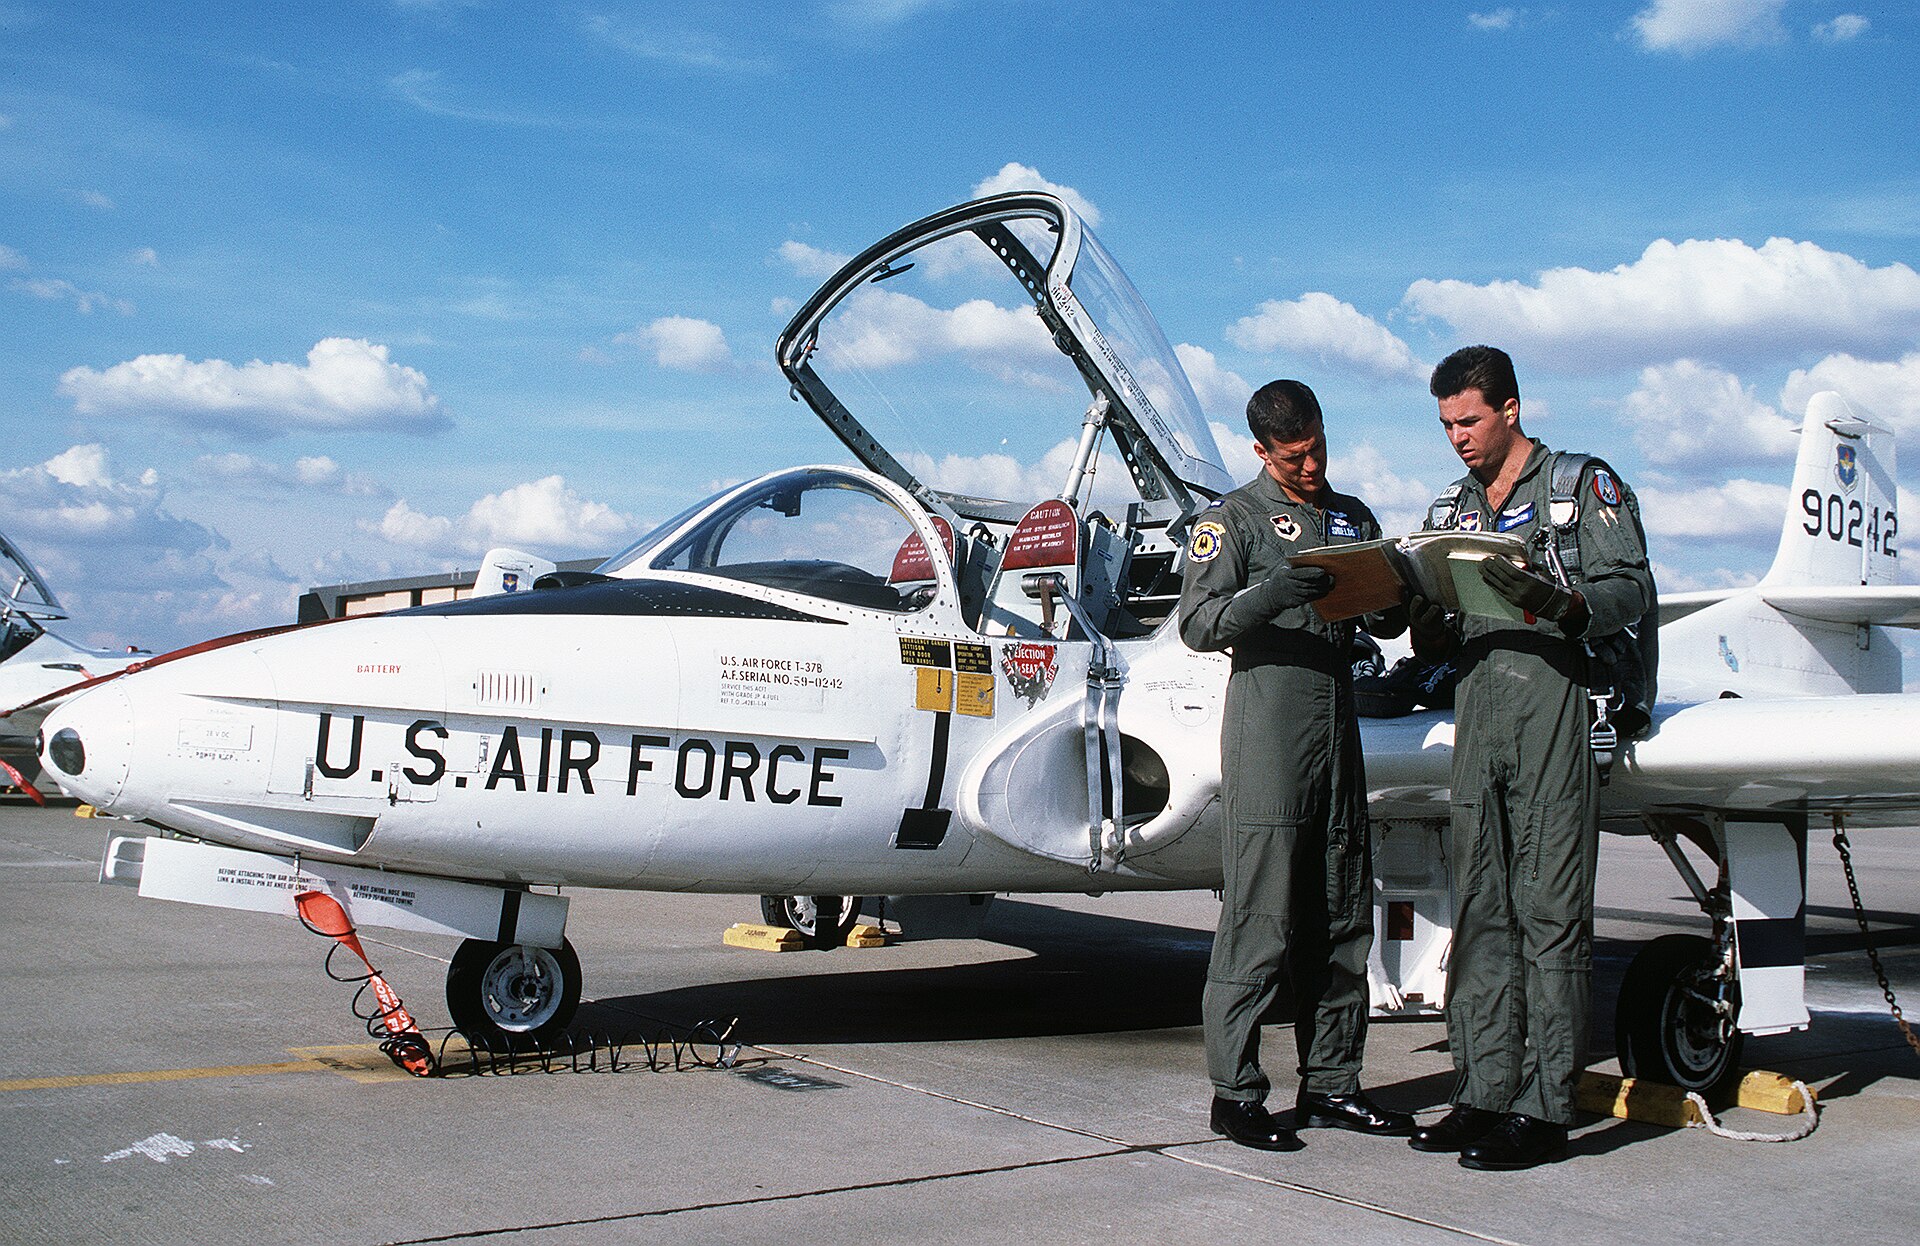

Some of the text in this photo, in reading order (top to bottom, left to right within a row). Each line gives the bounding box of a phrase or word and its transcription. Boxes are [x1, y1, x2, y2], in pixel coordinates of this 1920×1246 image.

[1030, 508, 1061, 520] CAUTION
[1802, 488, 1897, 557] 90242
[1014, 648, 1046, 659] EJECTION
[357, 664, 401, 673] BATTERY
[720, 656, 822, 673] U.S. AIR FORCE T-37B
[1021, 663, 1039, 674] SEAT
[314, 712, 850, 808] U.S. AIR FORCE
[238, 870, 264, 879] ATTACHING
